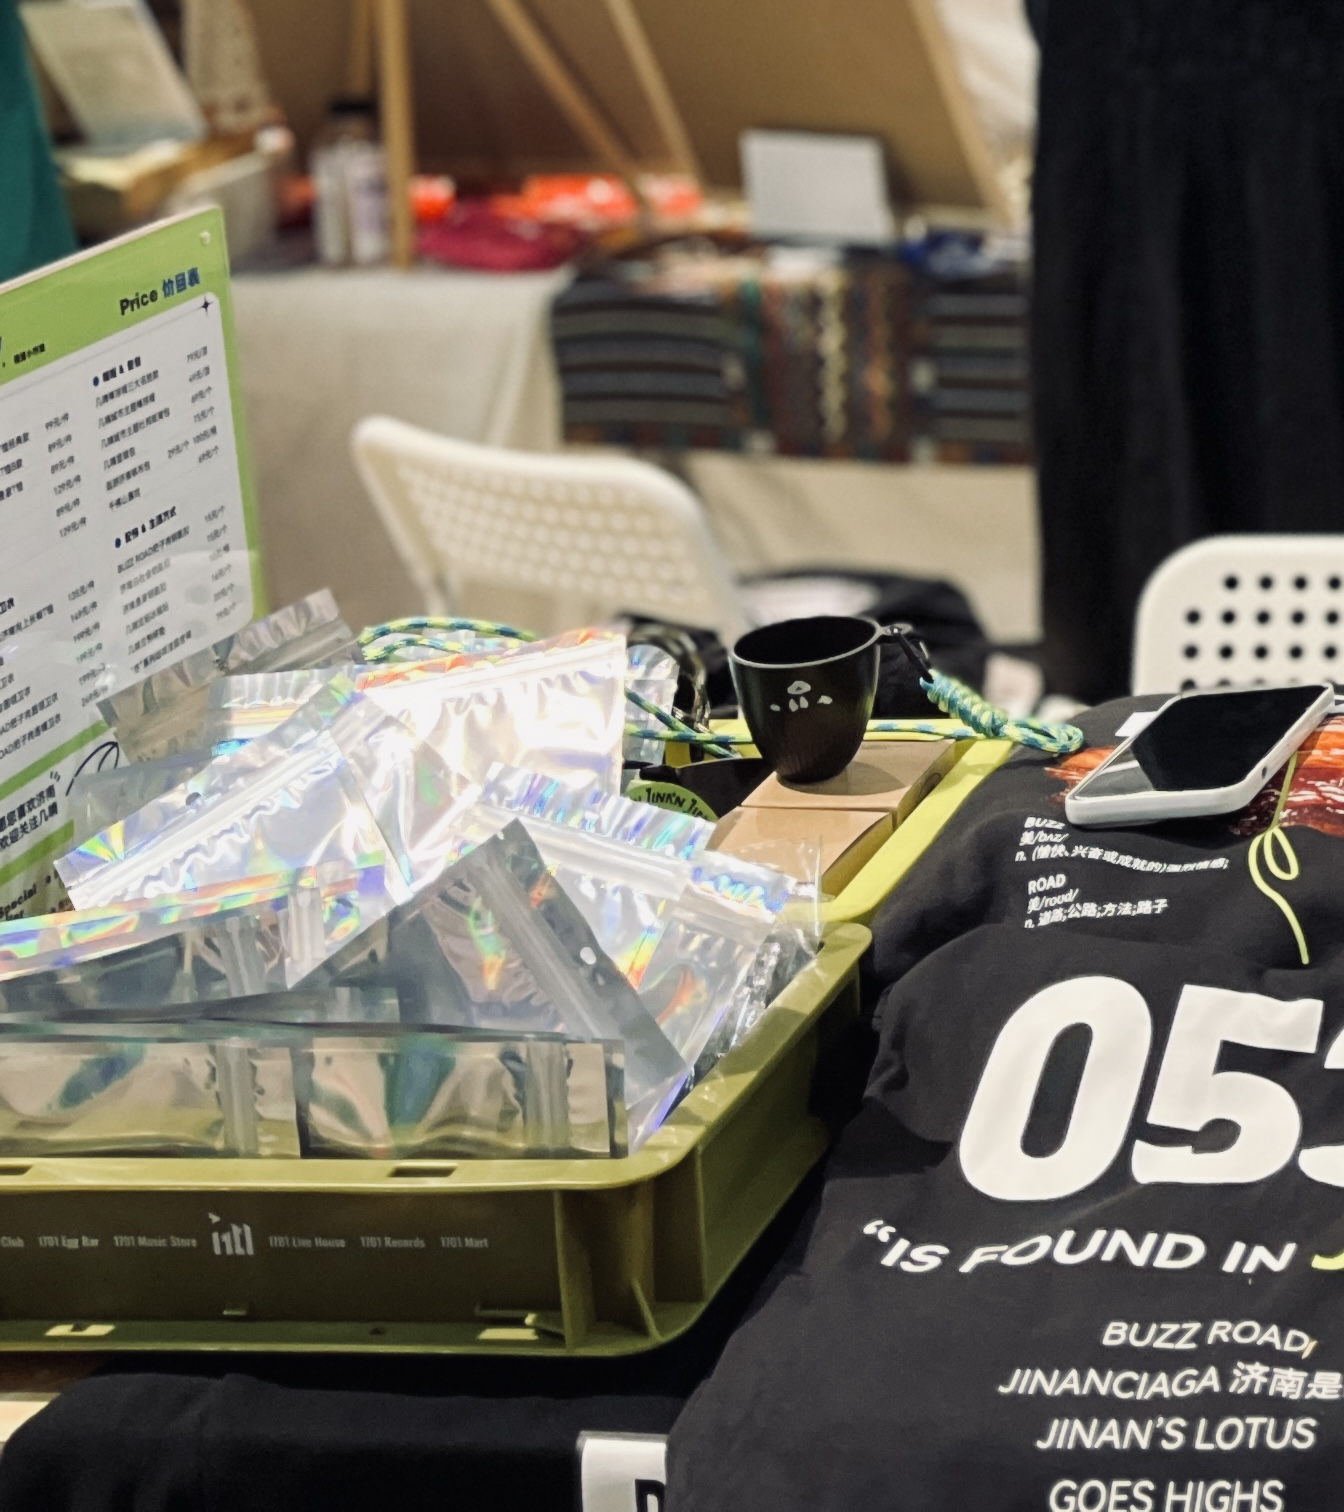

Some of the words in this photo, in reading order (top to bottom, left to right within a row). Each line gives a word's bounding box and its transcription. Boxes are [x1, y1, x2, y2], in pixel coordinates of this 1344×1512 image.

[119, 289, 158, 316] Price
[1023, 816, 1066, 831] BUZZ
[1027, 873, 1067, 896] ROAD
[170, 1235, 197, 1248] Store
[292, 1236, 313, 1248] Live
[314, 1236, 346, 1248] House
[384, 1236, 426, 1248] Records
[958, 1229, 1207, 1275] FOUND
[1221, 1241, 1299, 1274] IN
[1101, 1321, 1201, 1350] BUZZ
[1207, 1320, 1312, 1354] ROAD
[998, 1365, 1222, 1400] JINANCIAGA
[1194, 1417, 1320, 1451] LOTUS
[1048, 1479, 1157, 1512] GOES
[1163, 1479, 1287, 1512] HIGHS
